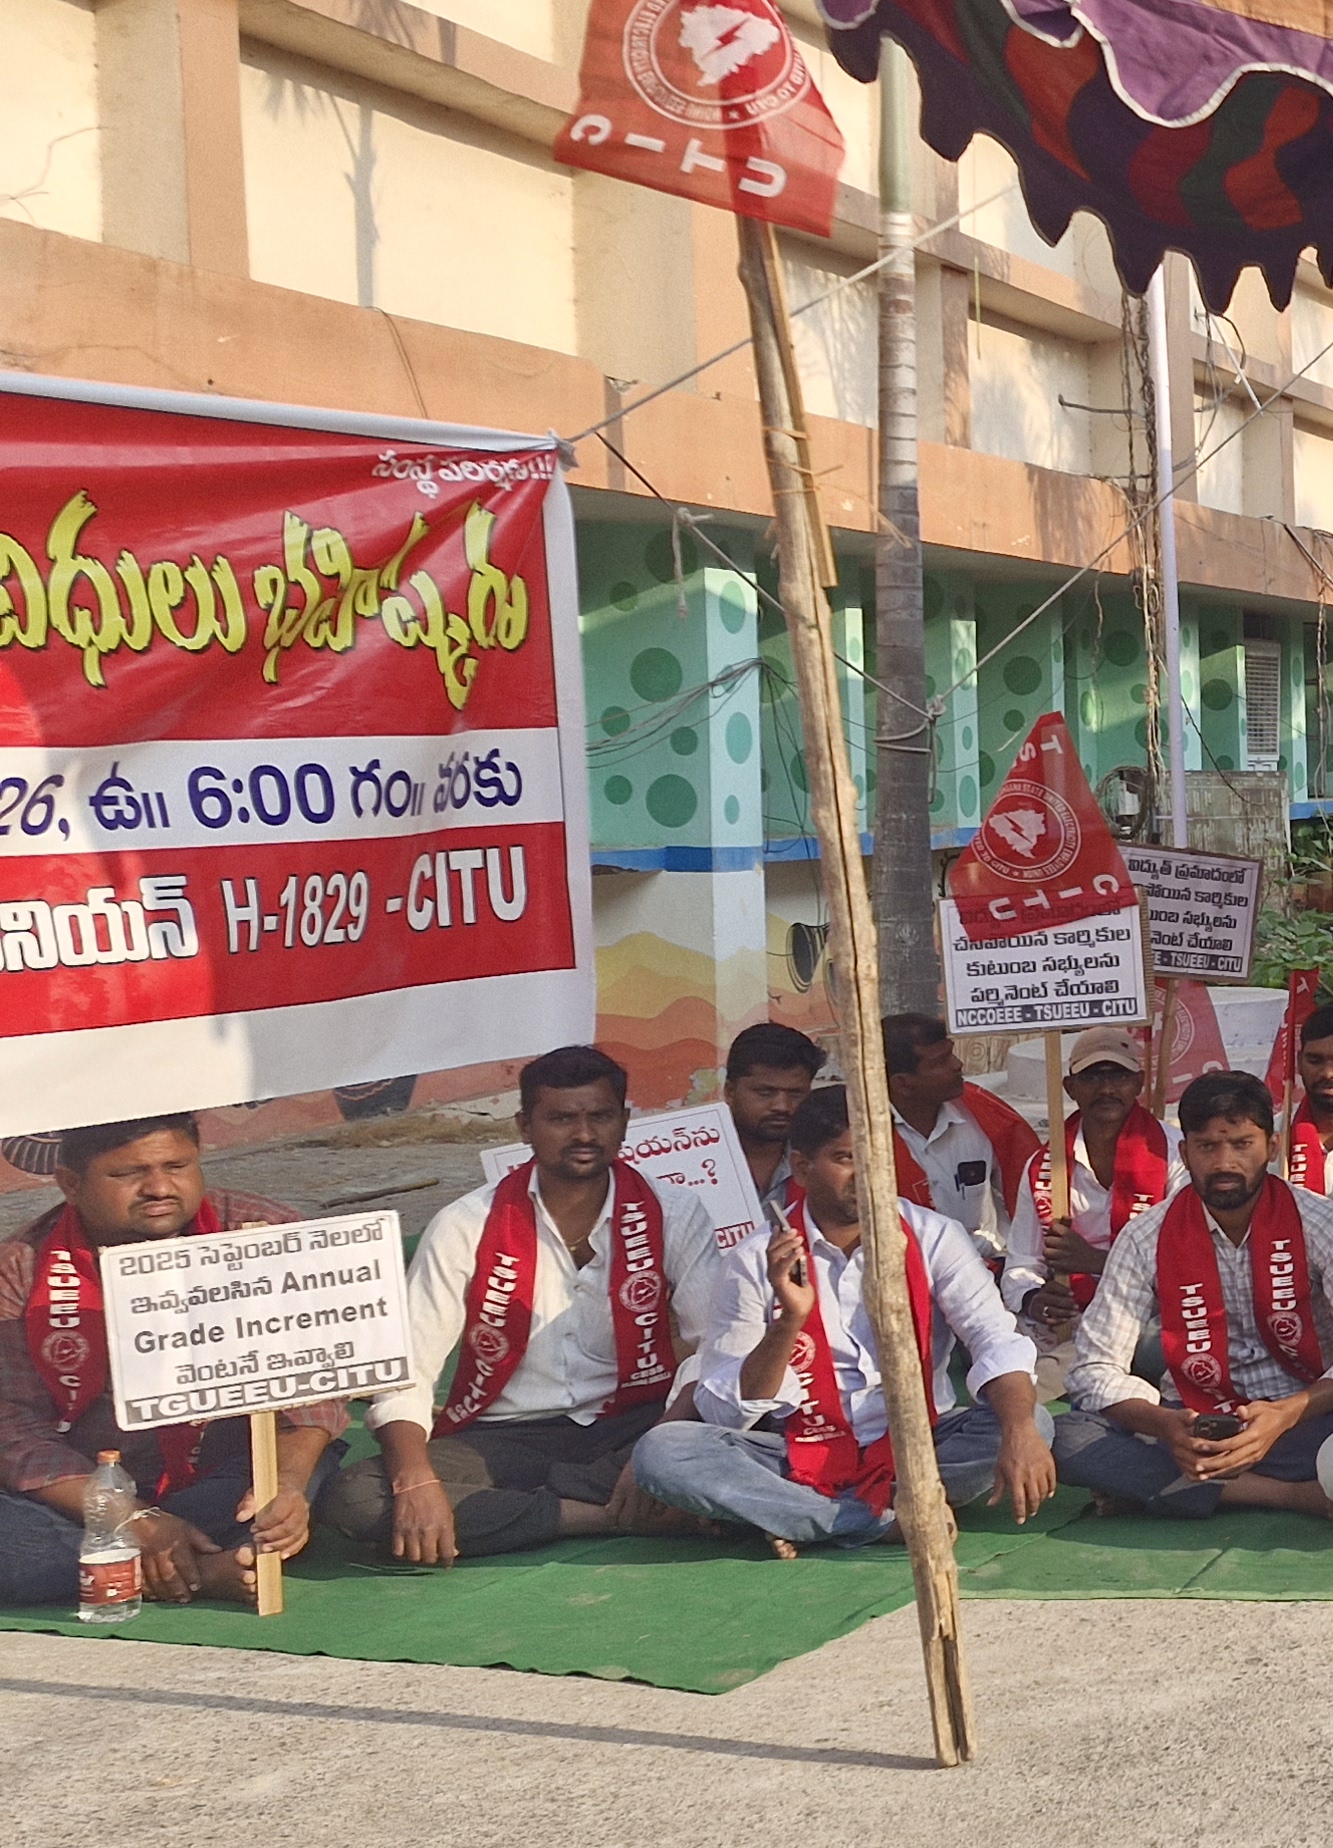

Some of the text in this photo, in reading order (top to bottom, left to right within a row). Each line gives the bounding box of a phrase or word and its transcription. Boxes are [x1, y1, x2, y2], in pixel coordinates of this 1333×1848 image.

[187, 763, 335, 830] 6:00
[433, 749, 522, 815] వరకు
[221, 869, 369, 954] H-1829
[966, 961, 1037, 977] కుటుంబ
[1170, 952, 1242, 973] TSUEEU CITU
[1053, 978, 1120, 998] చేయాలి
[956, 998, 1137, 1027] NCCOEEE TSUEEU CITU
[118, 1248, 192, 1278] 2025
[280, 1258, 382, 1295] Annual
[133, 1296, 389, 1355] Grade Increment
[174, 1349, 260, 1386] వెంటనే
[131, 1359, 404, 1422] TGUEEU-CITU
